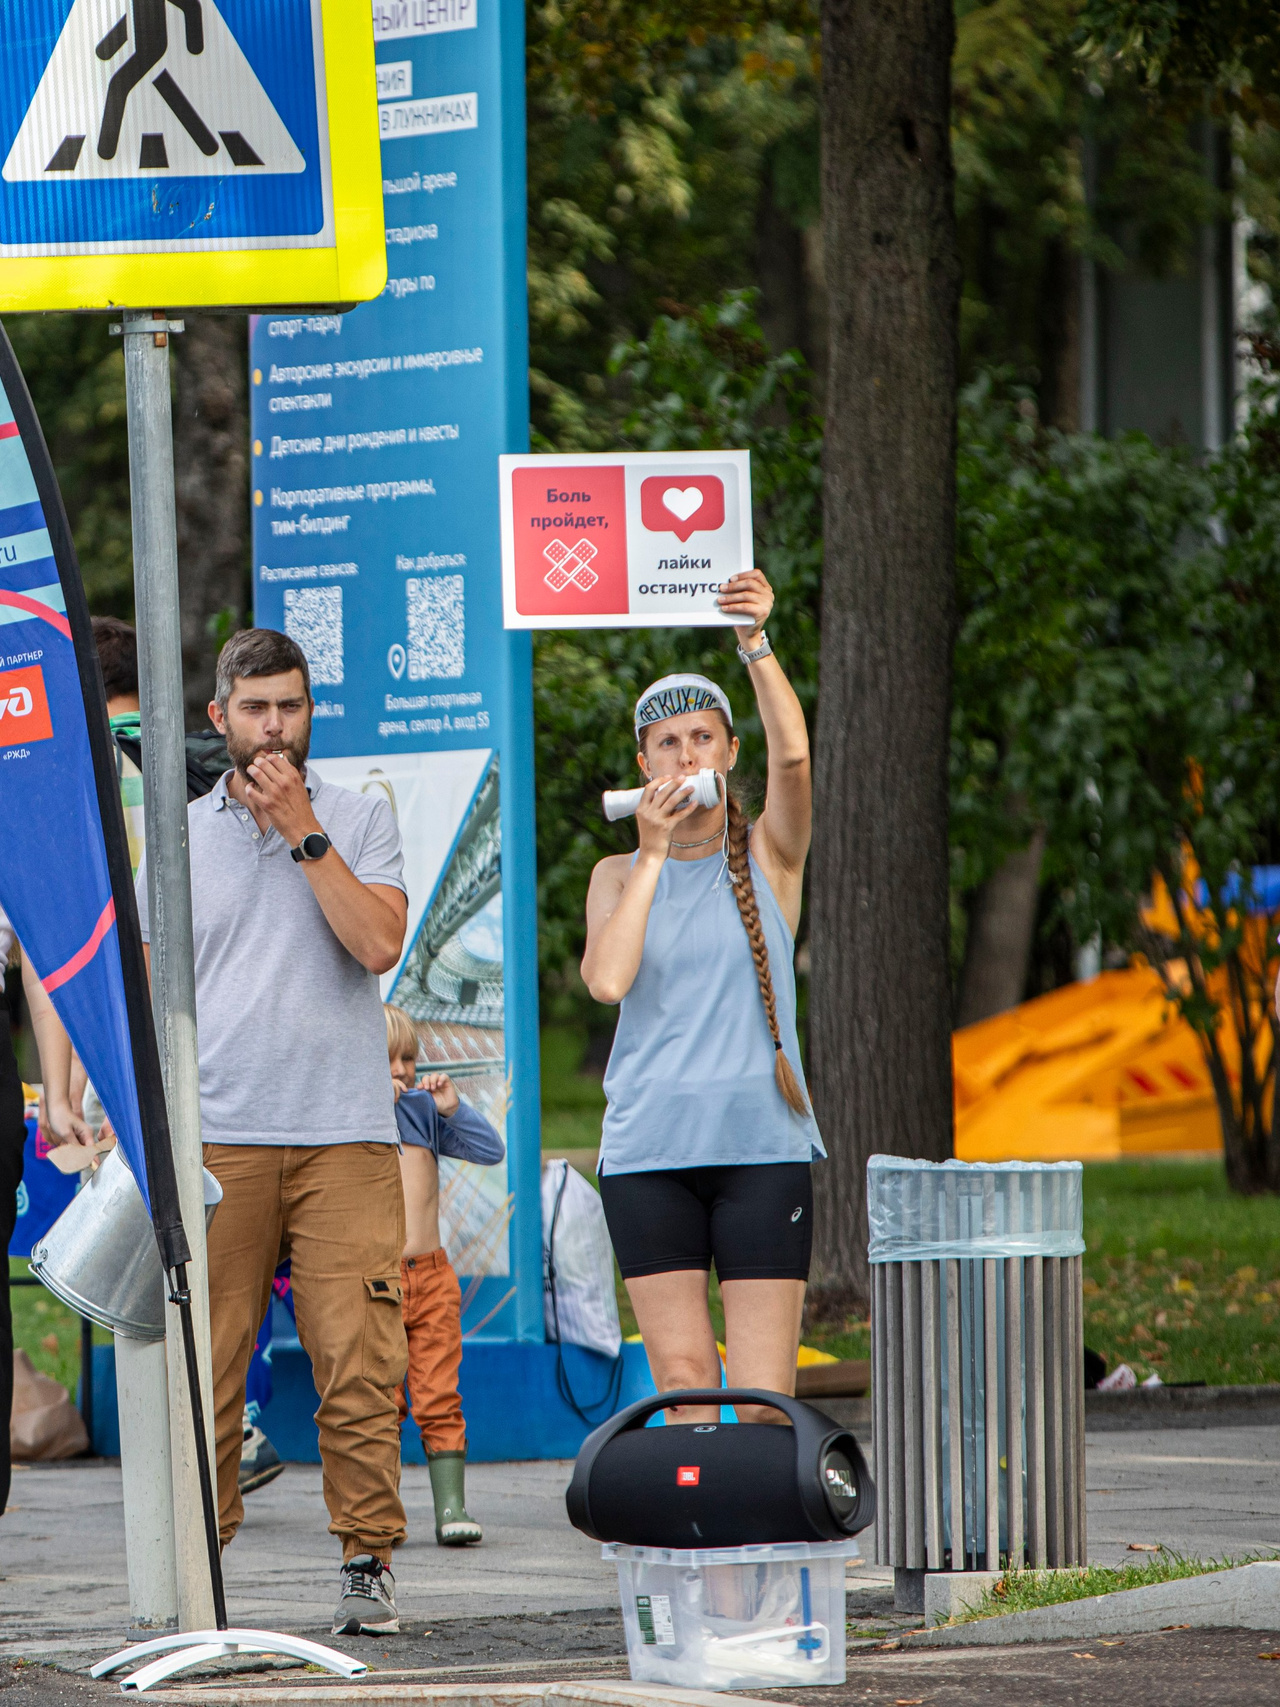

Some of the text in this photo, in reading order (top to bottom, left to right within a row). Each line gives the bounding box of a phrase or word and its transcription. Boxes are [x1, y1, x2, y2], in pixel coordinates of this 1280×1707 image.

[413, 0, 470, 30] ЦЕНТР
[381, 99, 472, 131] В ЛУЖНИКАХ
[422, 171, 457, 194] арене
[420, 275, 436, 291] по
[269, 347, 483, 386] Авторские экскурсии и иммерсивные
[269, 393, 332, 413] спектакли
[270, 423, 459, 459] Детские дни рождения и квесты
[271, 479, 436, 509] Корпоративные программы,
[546, 488, 591, 503] Боль
[271, 514, 350, 536] тим-билдинг
[531, 514, 609, 531] пройдет,
[396, 554, 415, 571] Как
[658, 555, 711, 570] лайки
[260, 565, 318, 583] Расписание
[6, 650, 44, 665] ПАРТНЕР
[385, 691, 483, 711] Большая спортивная
[409, 718, 442, 734] сектор
[453, 716, 477, 730] вход
[3, 749, 31, 762] «РЖД»
